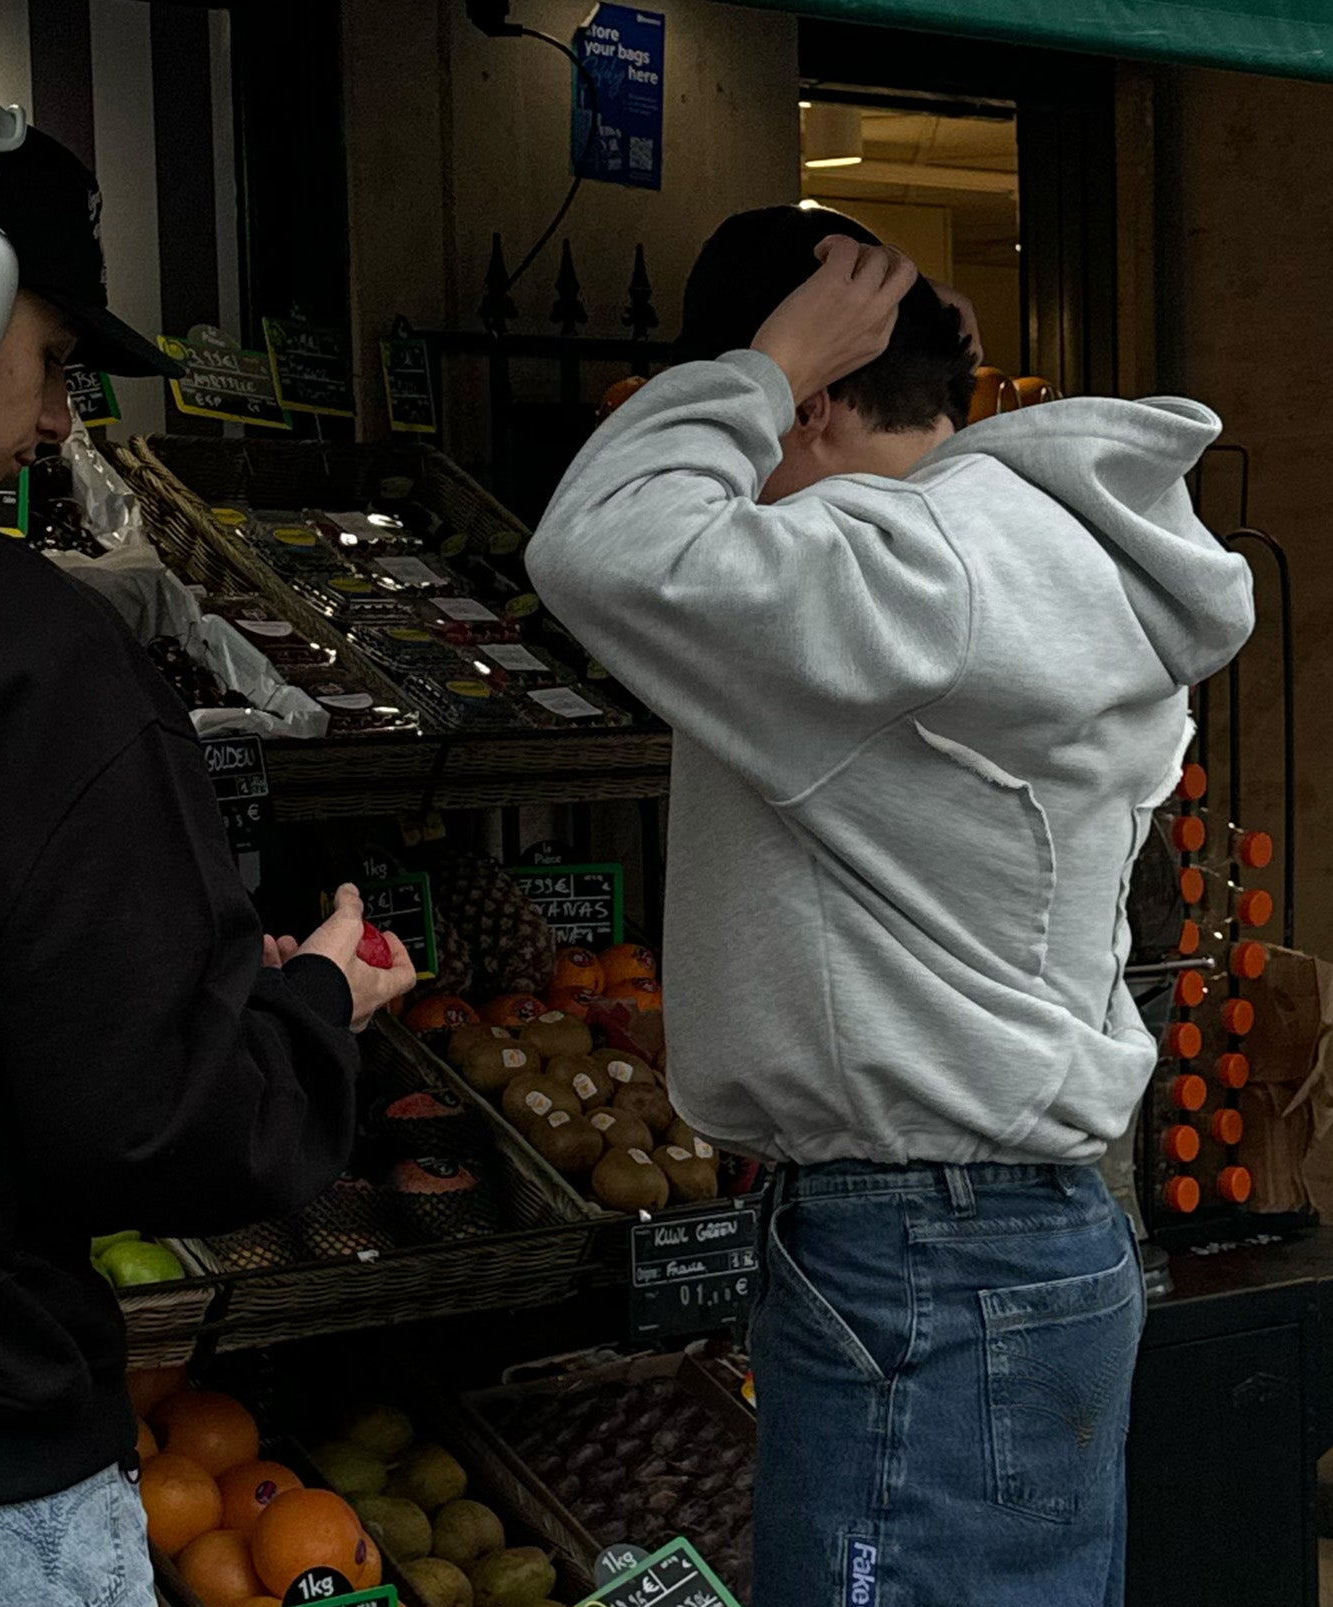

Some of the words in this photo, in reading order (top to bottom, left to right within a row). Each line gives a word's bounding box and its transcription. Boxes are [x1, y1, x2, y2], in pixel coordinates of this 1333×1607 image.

[584, 23, 620, 41] tore
[584, 39, 616, 57] your
[617, 43, 651, 66] bags
[627, 65, 659, 85] here
[363, 857, 387, 880] 1kg
[602, 1551, 638, 1574] 1kg
[298, 1573, 335, 1600] 1kg
